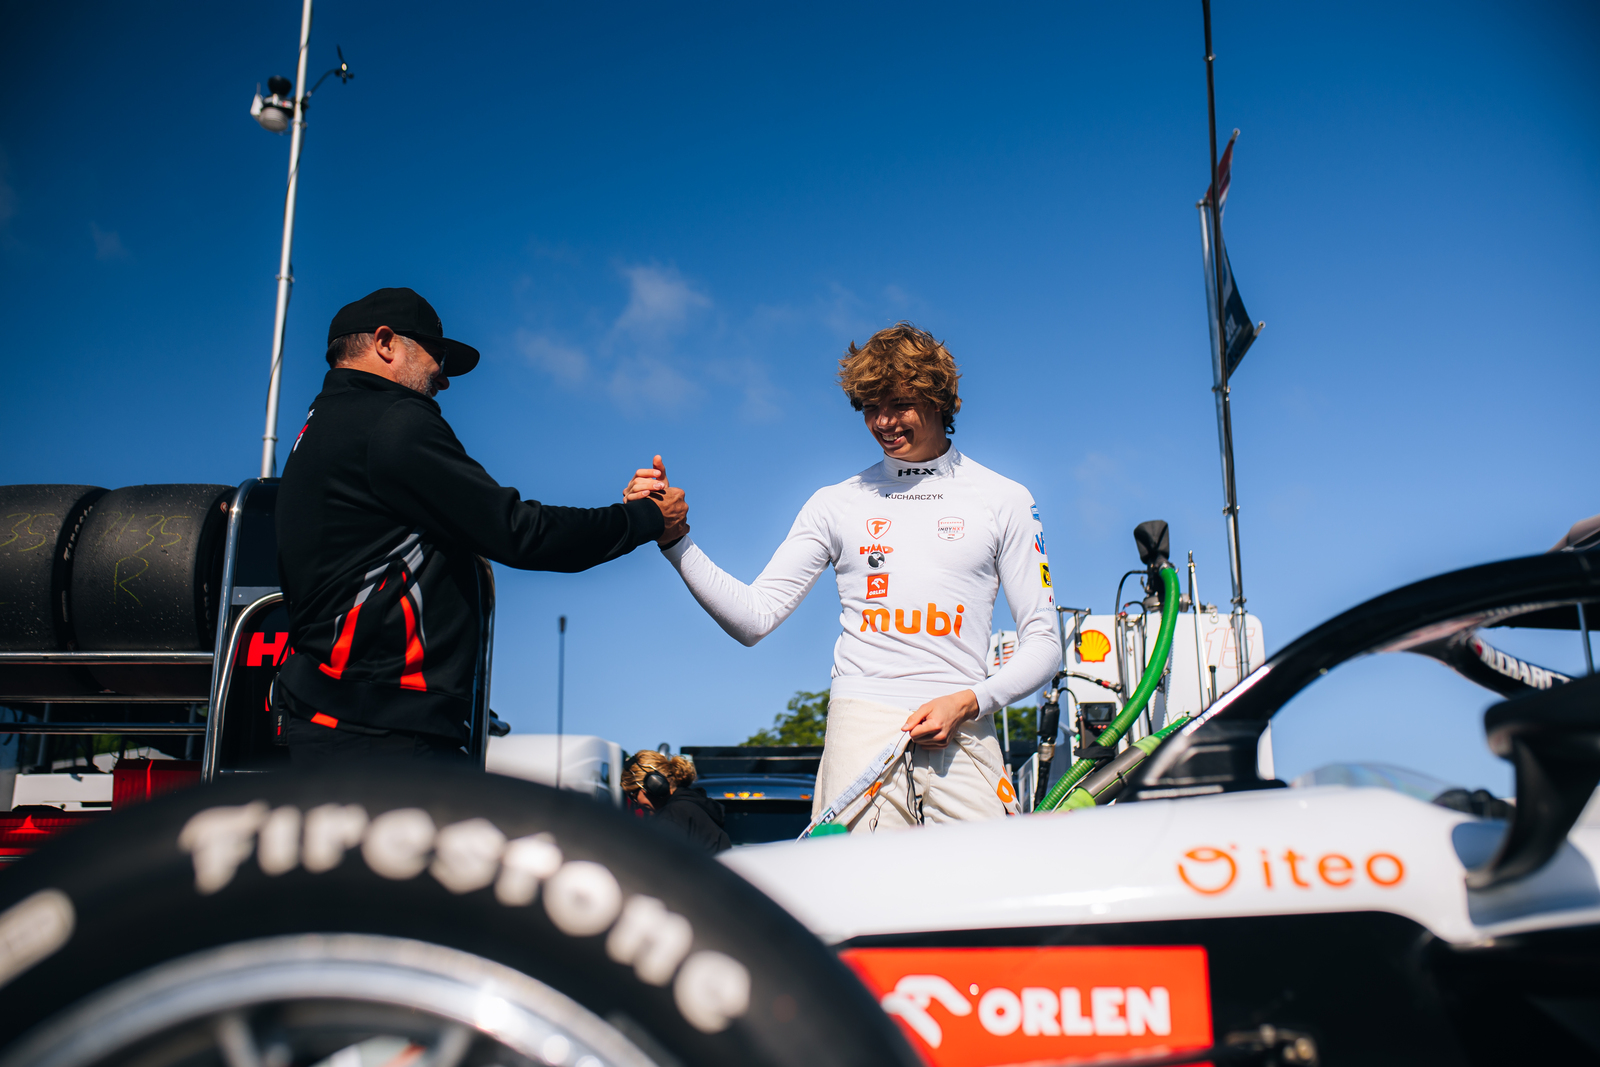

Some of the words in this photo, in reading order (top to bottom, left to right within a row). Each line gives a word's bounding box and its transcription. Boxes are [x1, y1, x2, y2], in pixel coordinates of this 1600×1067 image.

[897, 467, 937, 478] HRX
[885, 492, 944, 501] KUCHARCZYK
[868, 588, 887, 597] ORLEN
[860, 602, 965, 639] mubi
[1259, 847, 1406, 891] iteo
[177, 800, 752, 1035] Firestone
[977, 986, 1172, 1037] ORLEN
